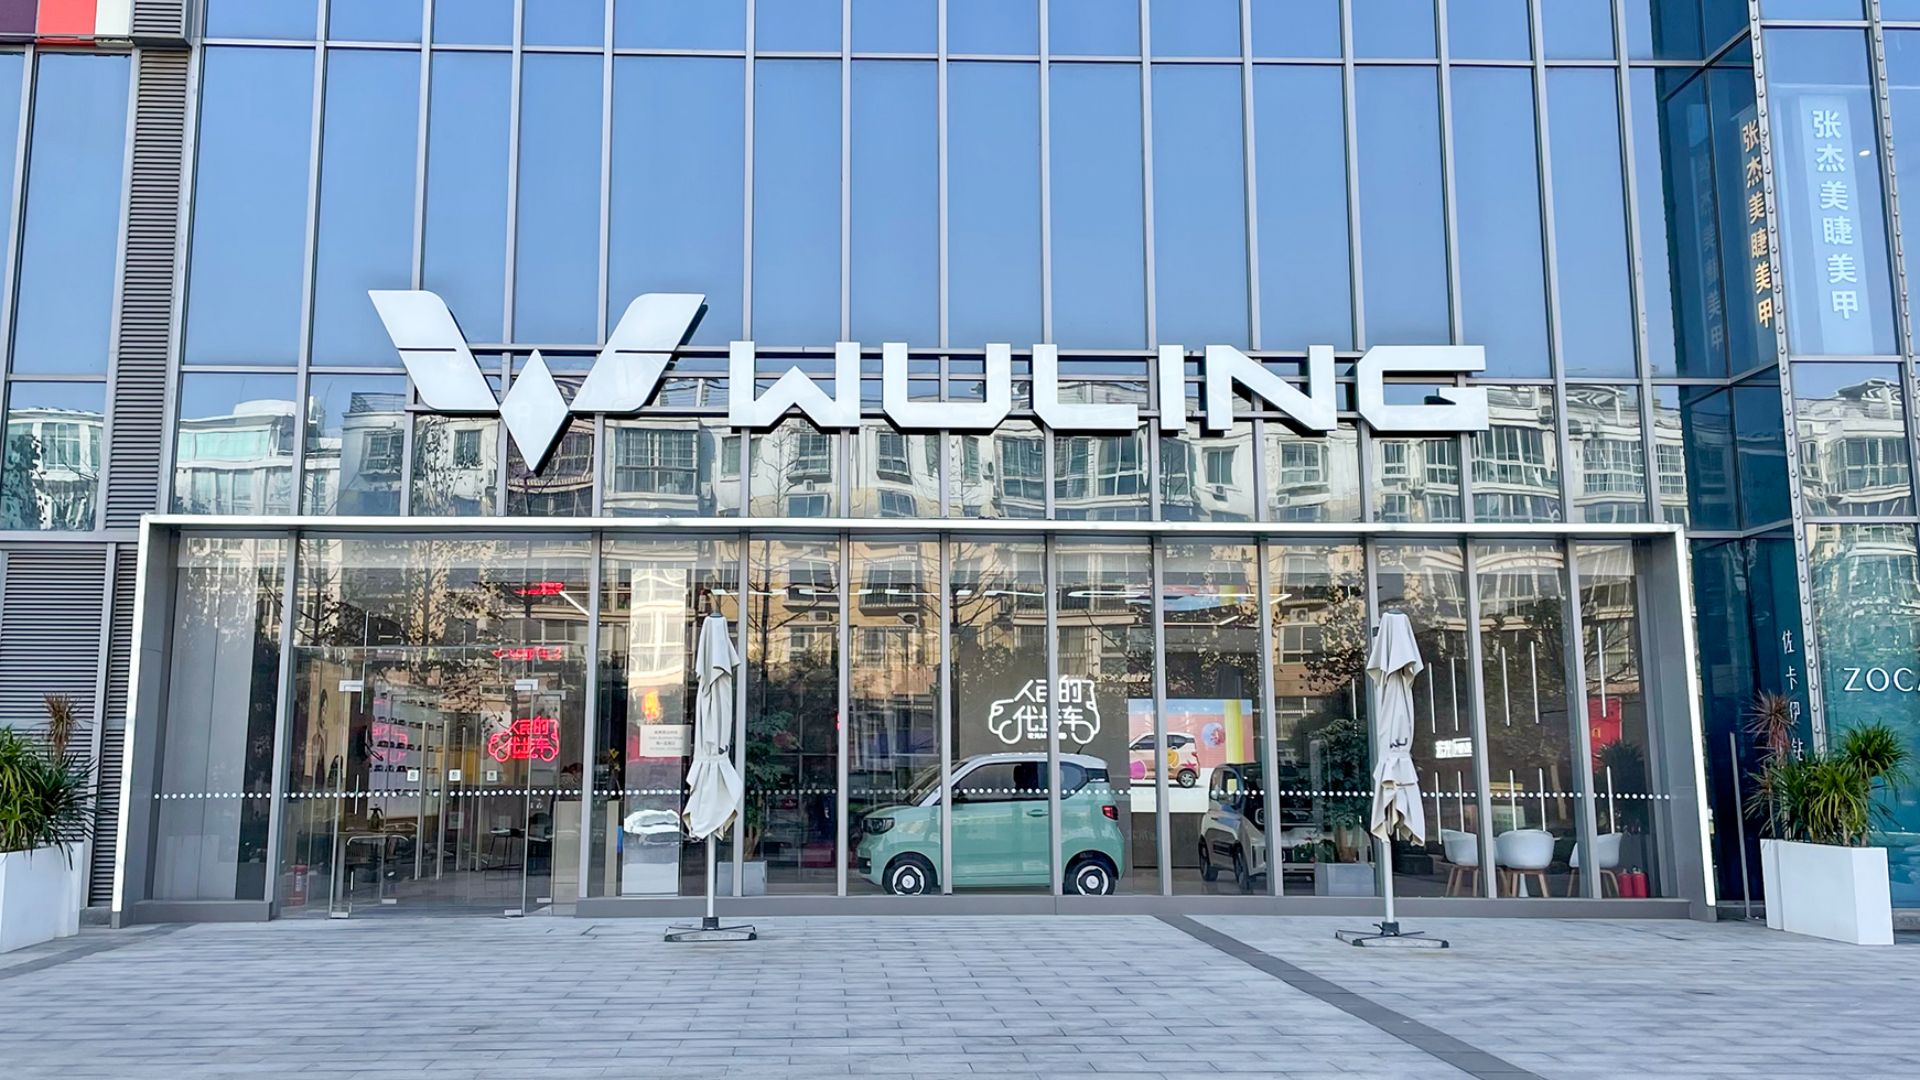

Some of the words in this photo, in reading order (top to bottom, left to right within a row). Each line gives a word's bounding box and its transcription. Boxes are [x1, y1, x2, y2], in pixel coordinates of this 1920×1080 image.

[1812, 109, 1859, 320] 张杰美睫美甲
[728, 341, 1489, 433] WULING
[1844, 667, 1920, 692] ZOC
